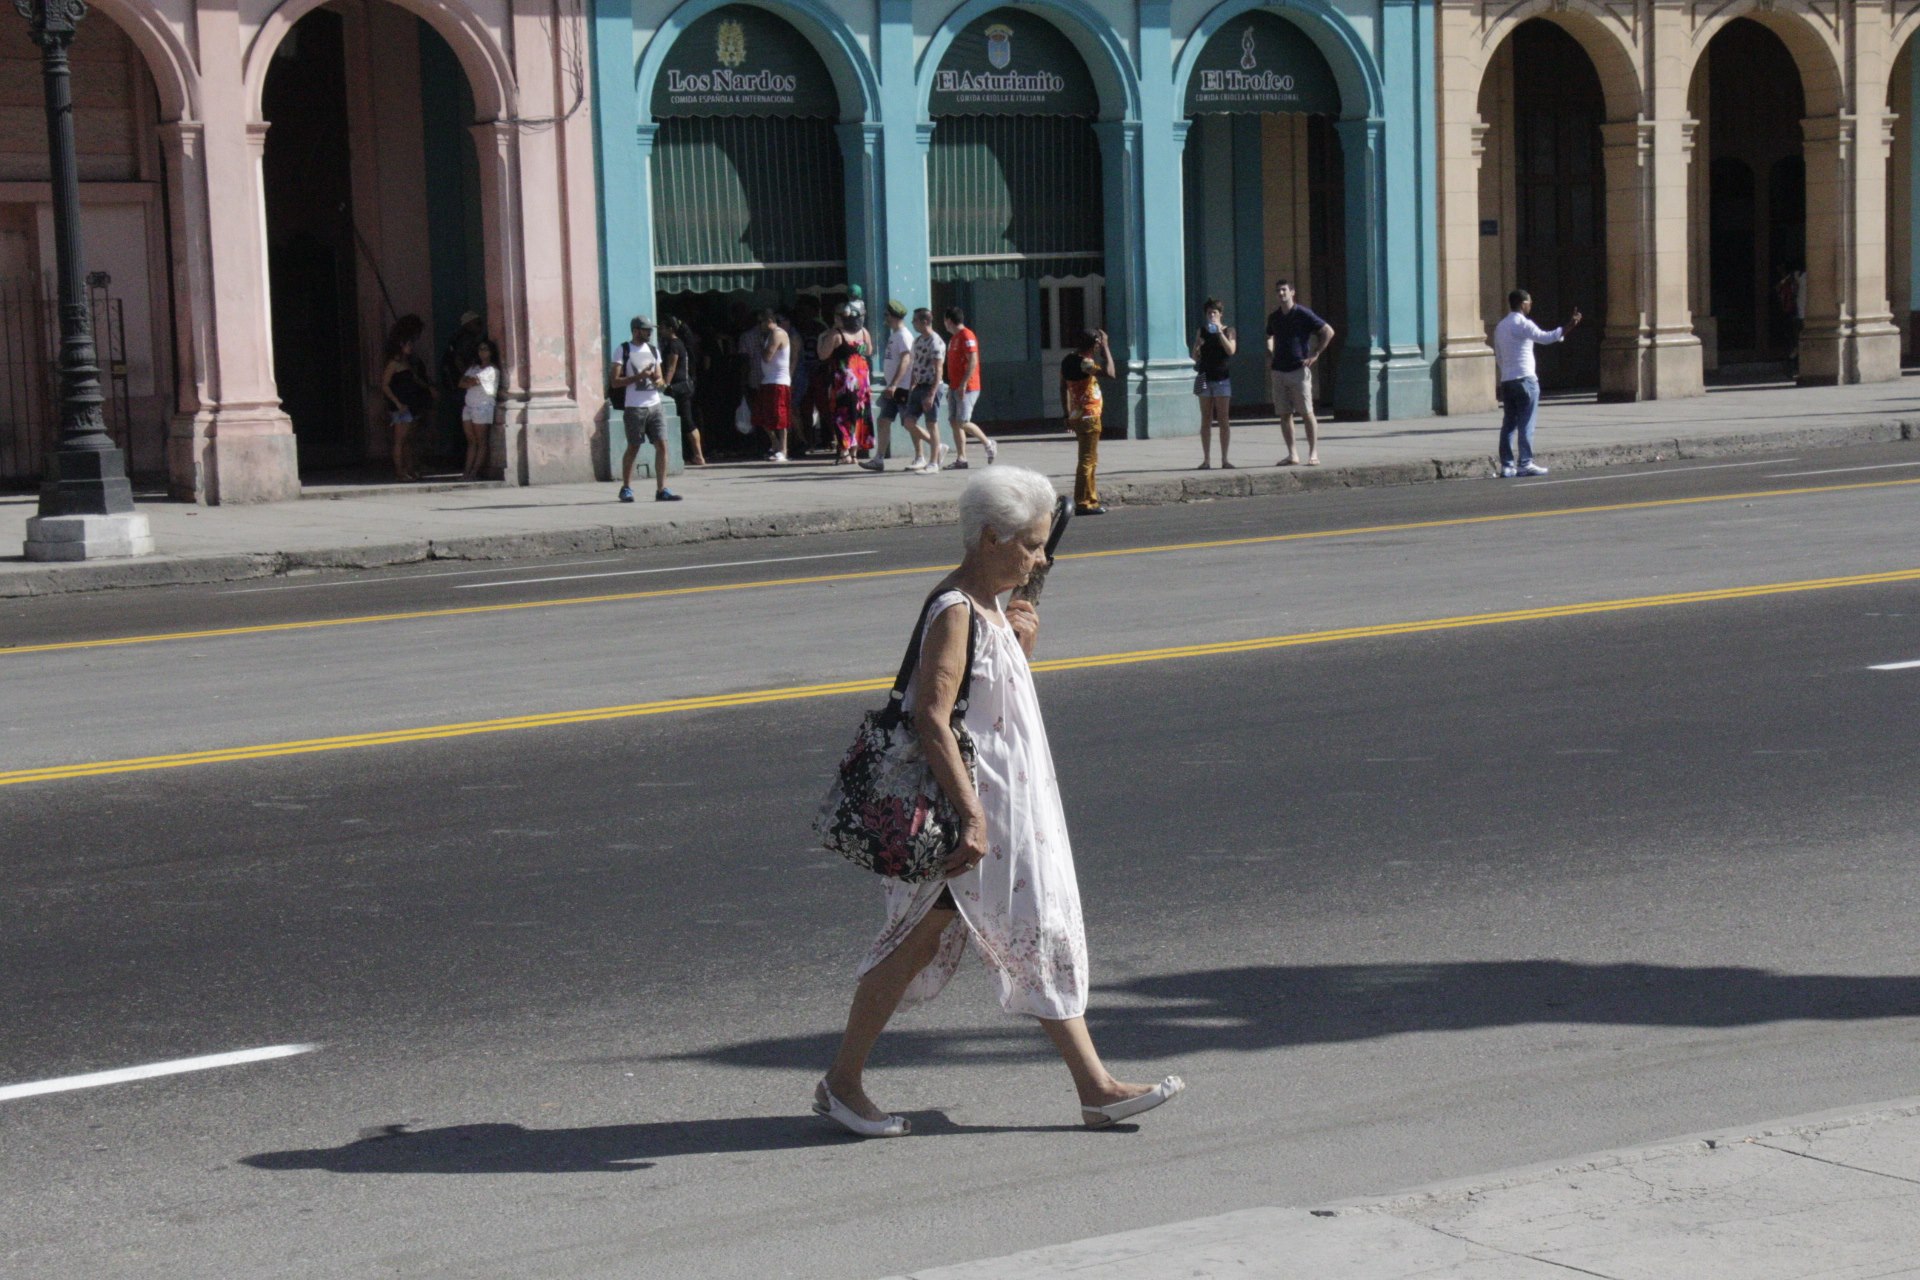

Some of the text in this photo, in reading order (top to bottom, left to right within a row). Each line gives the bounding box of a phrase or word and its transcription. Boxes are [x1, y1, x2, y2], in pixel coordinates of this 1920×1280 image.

[668, 70, 796, 91] Los Nardos
[936, 70, 1064, 91] El Asturianito
[1201, 70, 1294, 91] El Trofeo
[670, 95, 697, 104] COMIDA
[699, 94, 733, 104] ESPAÑOLA
[742, 95, 795, 103] INTERNACIONAL
[956, 95, 981, 103] COMIDA
[1195, 94, 1219, 102] COMIDA
[1220, 94, 1245, 102] CRIOLLA
[1252, 93, 1300, 101] INTERNACIONAL
